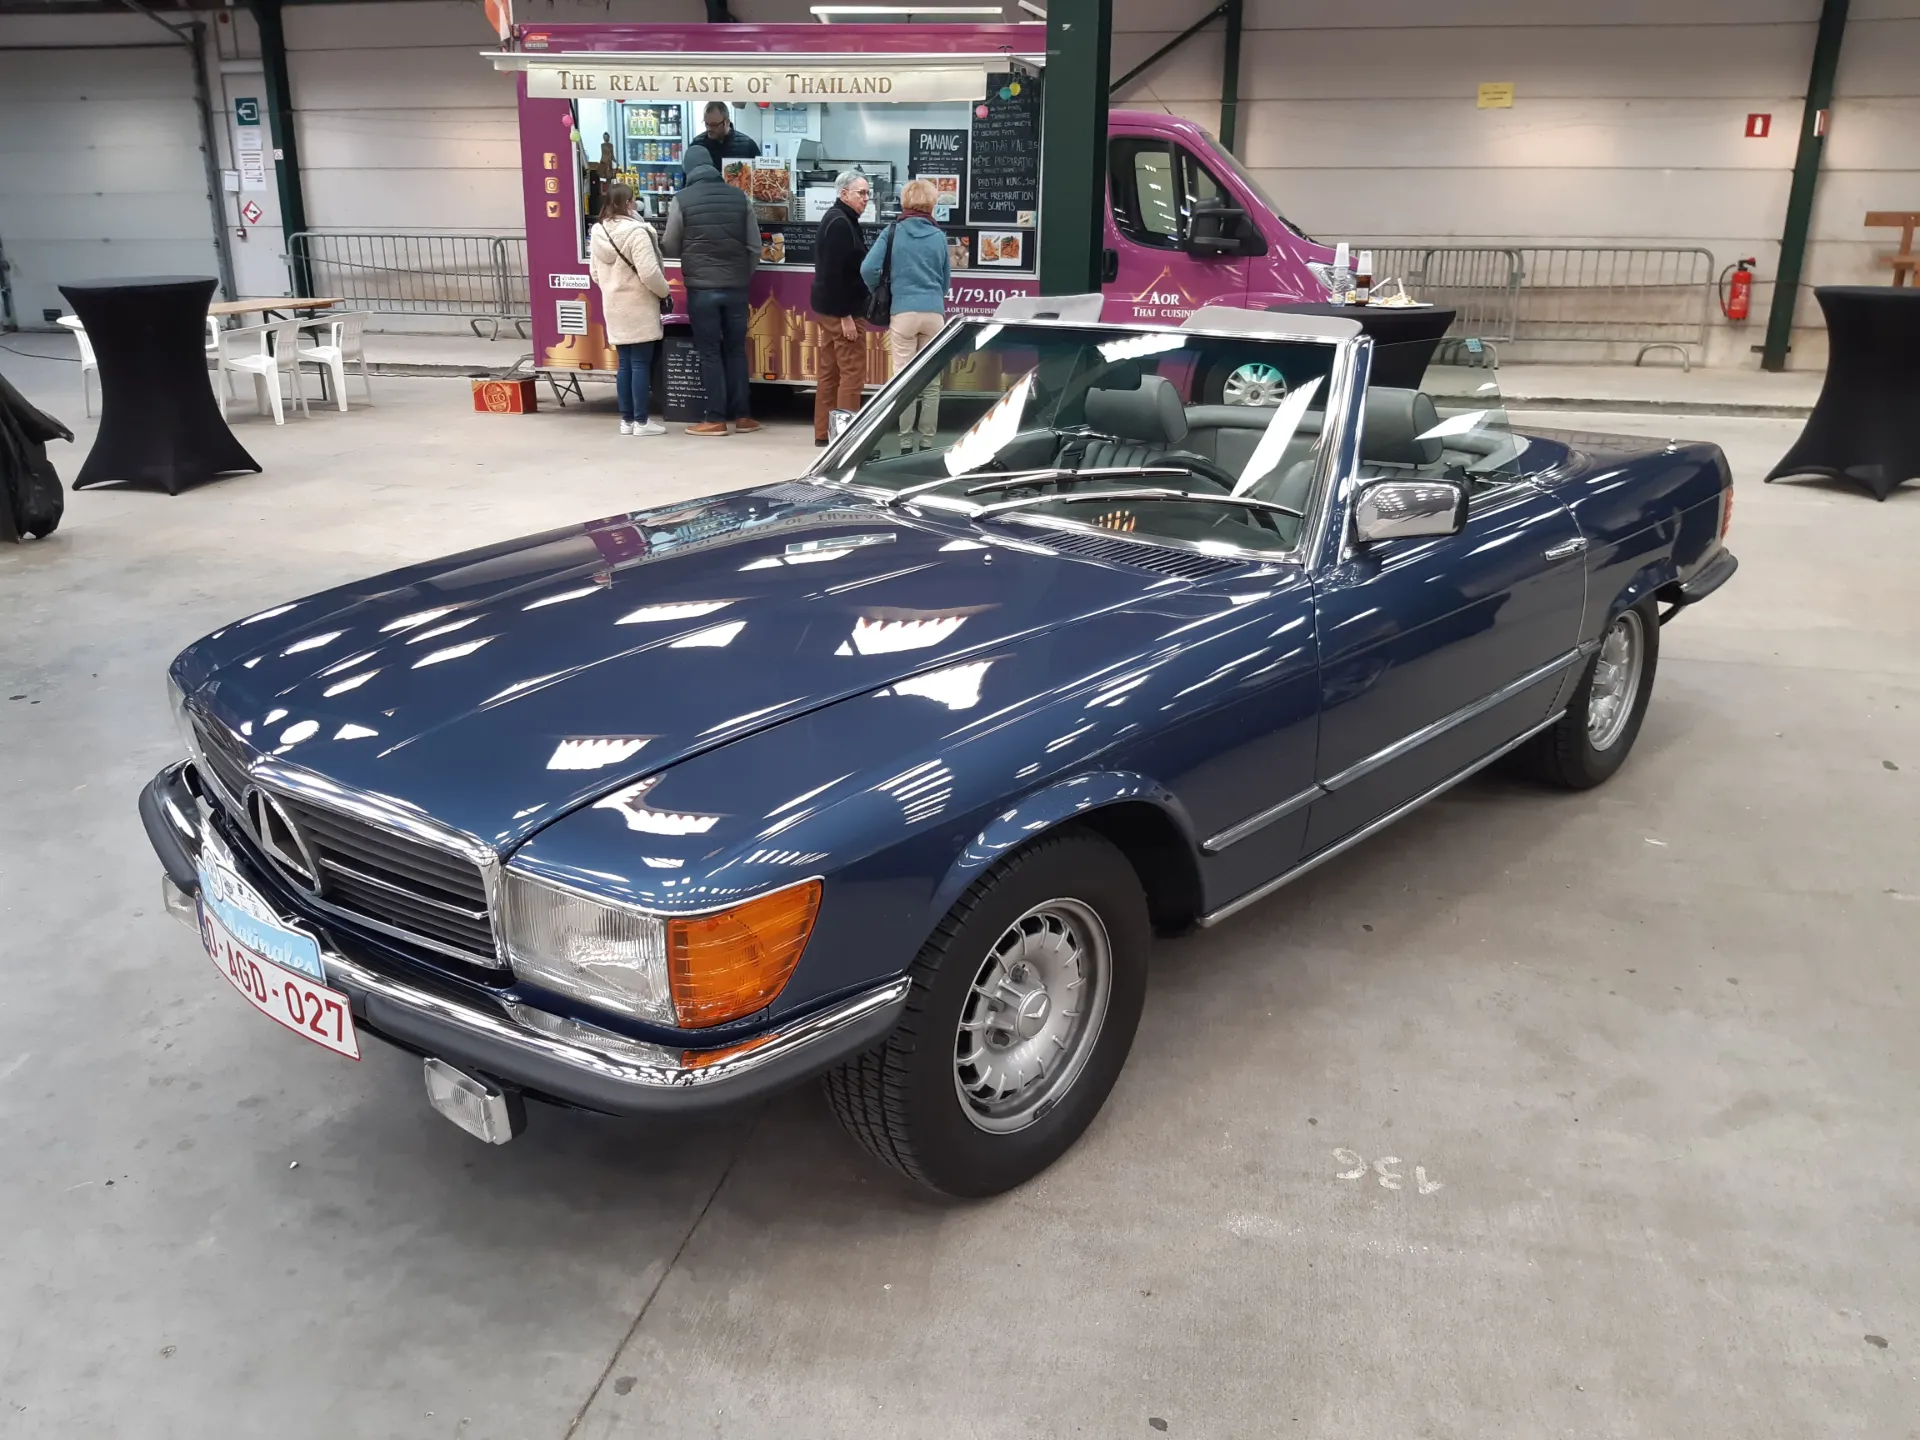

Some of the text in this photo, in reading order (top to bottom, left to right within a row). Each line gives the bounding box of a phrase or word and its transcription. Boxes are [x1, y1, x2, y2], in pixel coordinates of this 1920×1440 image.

[609, 75, 660, 92] REAL
[672, 76, 734, 93] TASTE
[747, 77, 773, 93] OF
[785, 74, 892, 94] THAILAND
[919, 133, 960, 151] PANANG
[1148, 292, 1180, 305] AOR
[1132, 307, 1156, 317] THAI
